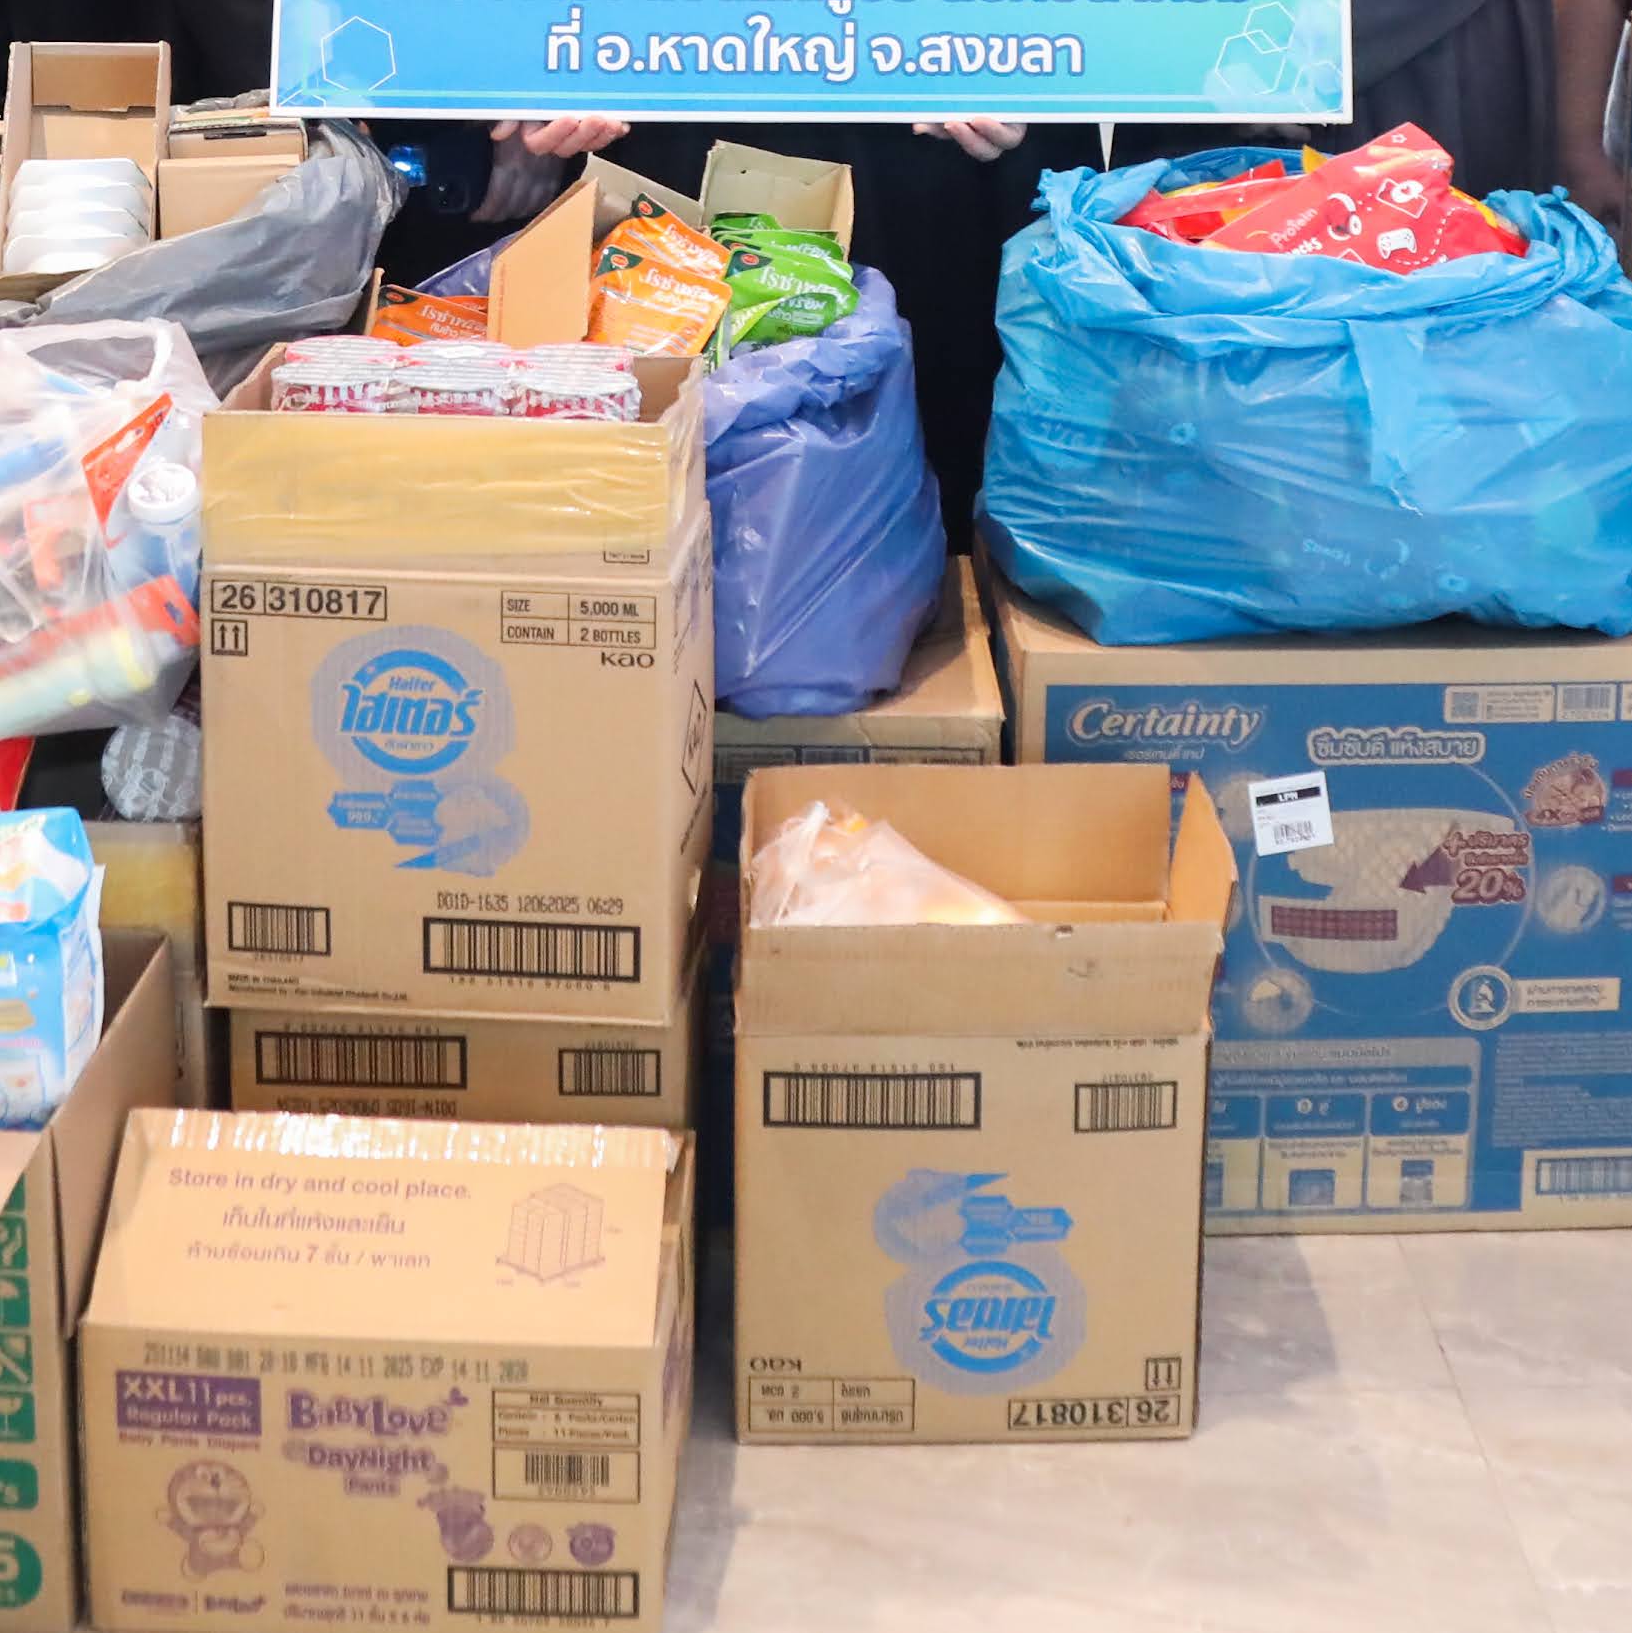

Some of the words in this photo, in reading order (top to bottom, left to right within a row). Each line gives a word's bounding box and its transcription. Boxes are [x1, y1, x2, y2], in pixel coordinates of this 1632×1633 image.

[547, 8, 582, 71] ที่
[596, 14, 856, 81] อ.หาดใหญ่
[870, 33, 1085, 75] จ.สงขลา
[1270, 208, 1319, 251] Protein
[220, 584, 257, 611] 26
[268, 586, 383, 617] 310817
[506, 597, 531, 613] SIZE
[579, 601, 620, 617] 5,000
[623, 603, 640, 618] ML
[506, 625, 555, 642] CONTAIN
[579, 627, 589, 642] 2
[592, 629, 642, 645] BOTTLES
[1070, 702, 1262, 744] Certainty
[1316, 733, 1385, 756] ซึมซับดี
[1391, 731, 1478, 757] แห้งสบาย
[168, 1167, 228, 1190] Store
[234, 1168, 255, 1190] in
[261, 1170, 298, 1195] dry
[303, 1173, 346, 1194] and
[351, 1175, 399, 1197] cool
[405, 1178, 472, 1203] place.
[122, 1376, 183, 1404] XXL
[125, 1406, 200, 1427] Regular
[206, 1410, 253, 1429] Pack
[1013, 1403, 1126, 1427] 310817
[1136, 1400, 1171, 1424] 26
